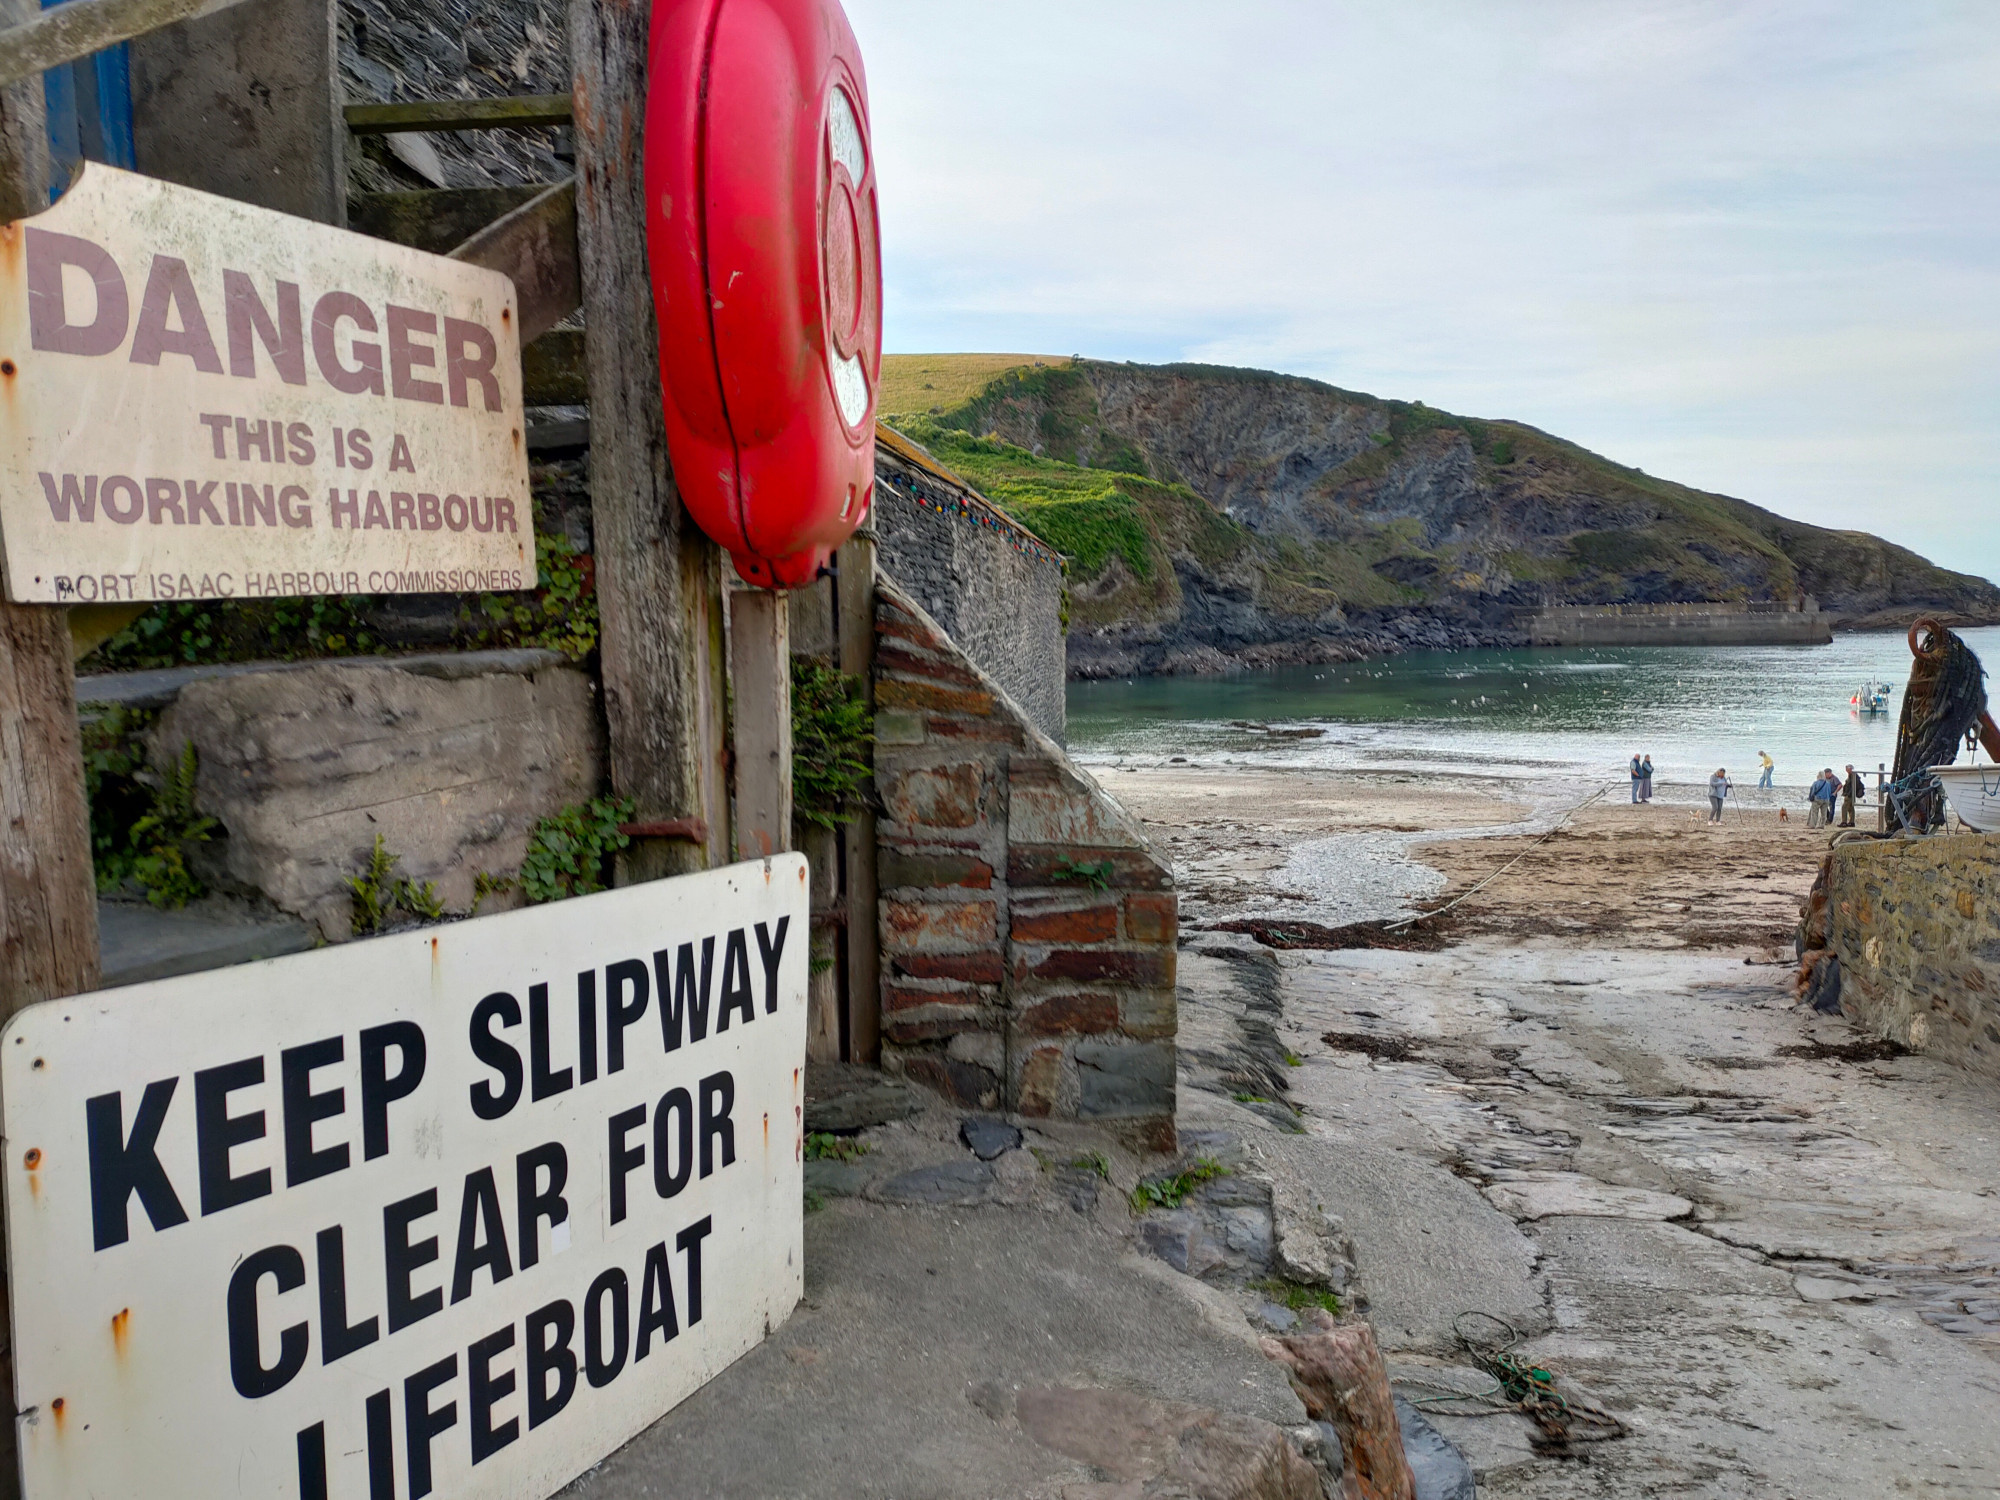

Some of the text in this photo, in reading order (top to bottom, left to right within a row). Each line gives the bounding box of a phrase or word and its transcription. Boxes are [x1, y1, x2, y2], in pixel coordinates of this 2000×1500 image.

[25, 226, 503, 413] DANGER
[38, 472, 518, 533] WORKING HARBOUR
[200, 413, 416, 473] THIS IS A
[54, 570, 523, 601] PORT ISAAC HARBOUR COMMISSIONERS
[86, 915, 791, 1253] KEEP SLIPWAY
[226, 1070, 736, 1400] CLEAR FOR
